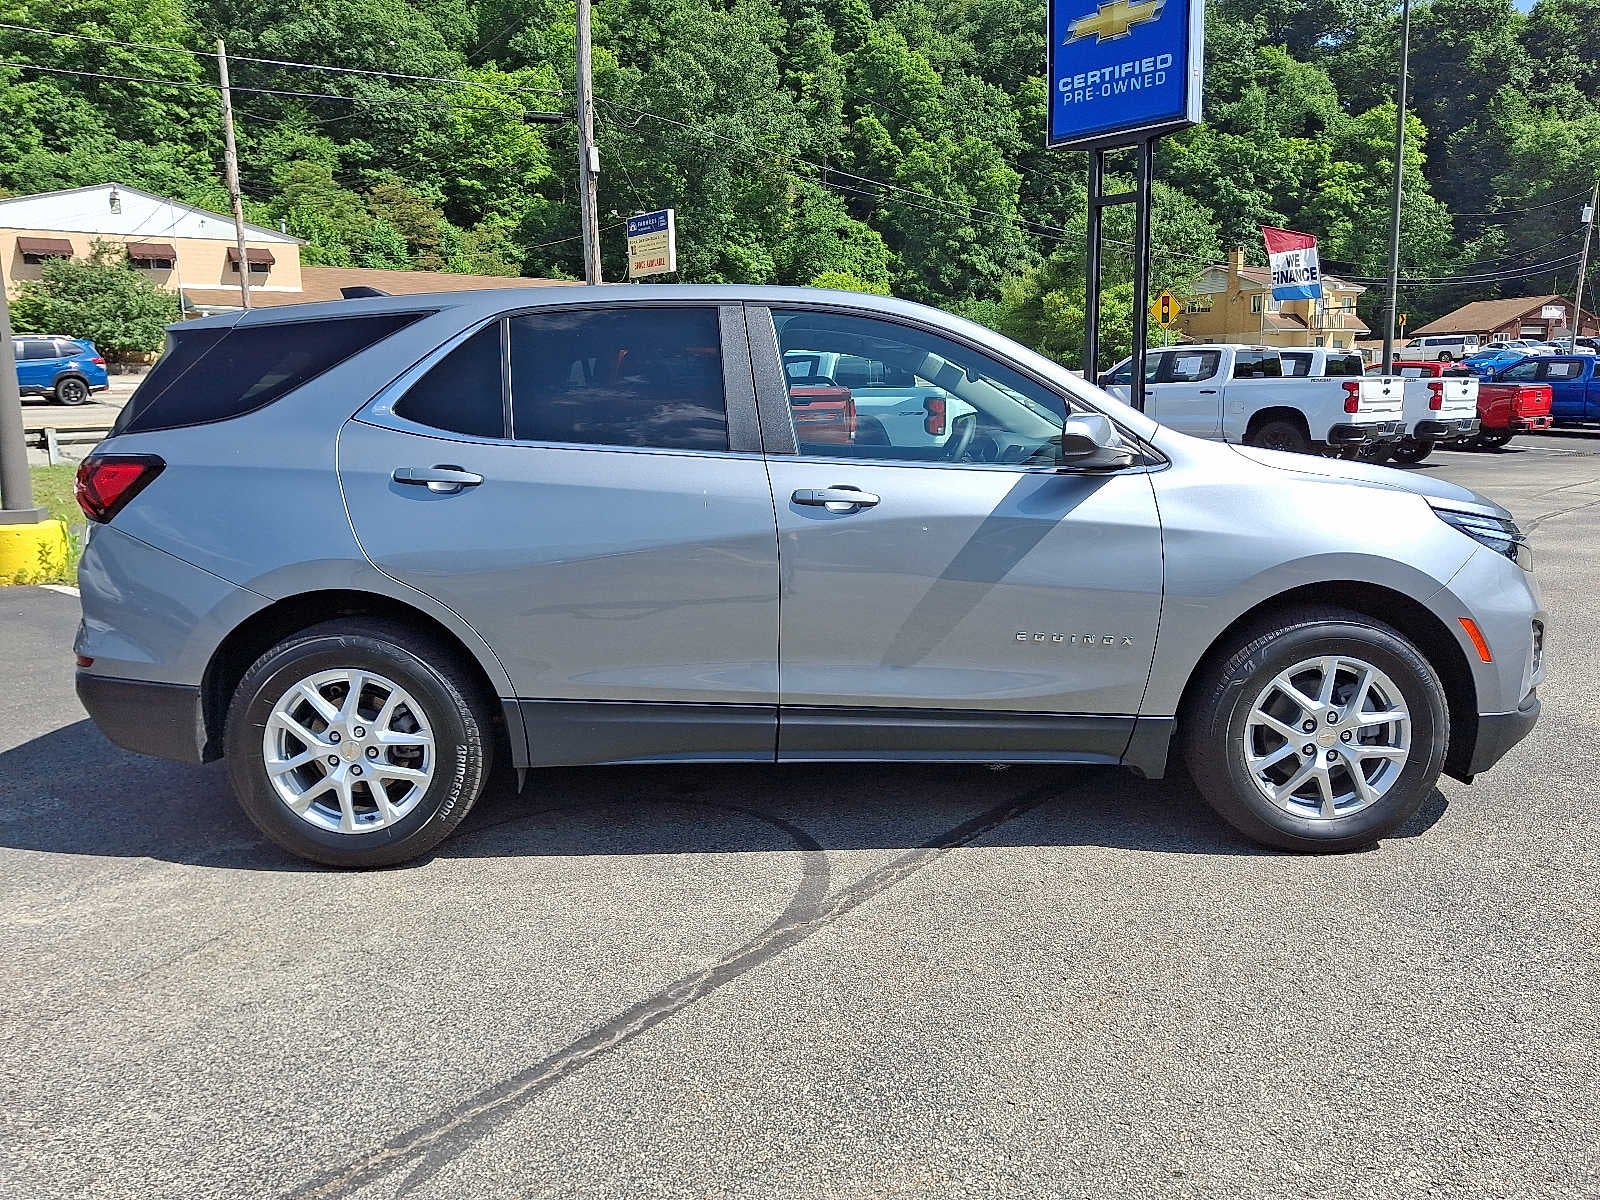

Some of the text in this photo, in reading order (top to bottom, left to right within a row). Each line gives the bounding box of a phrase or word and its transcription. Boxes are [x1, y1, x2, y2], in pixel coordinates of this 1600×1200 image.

[1058, 53, 1173, 92] CERTIFIED
[1063, 71, 1166, 106] PRE-OWNED
[1285, 253, 1301, 268] WE
[1272, 266, 1318, 285] FINANCE
[1016, 631, 1134, 646] EQUINOX
[437, 744, 468, 822] BRIDGESTONE
